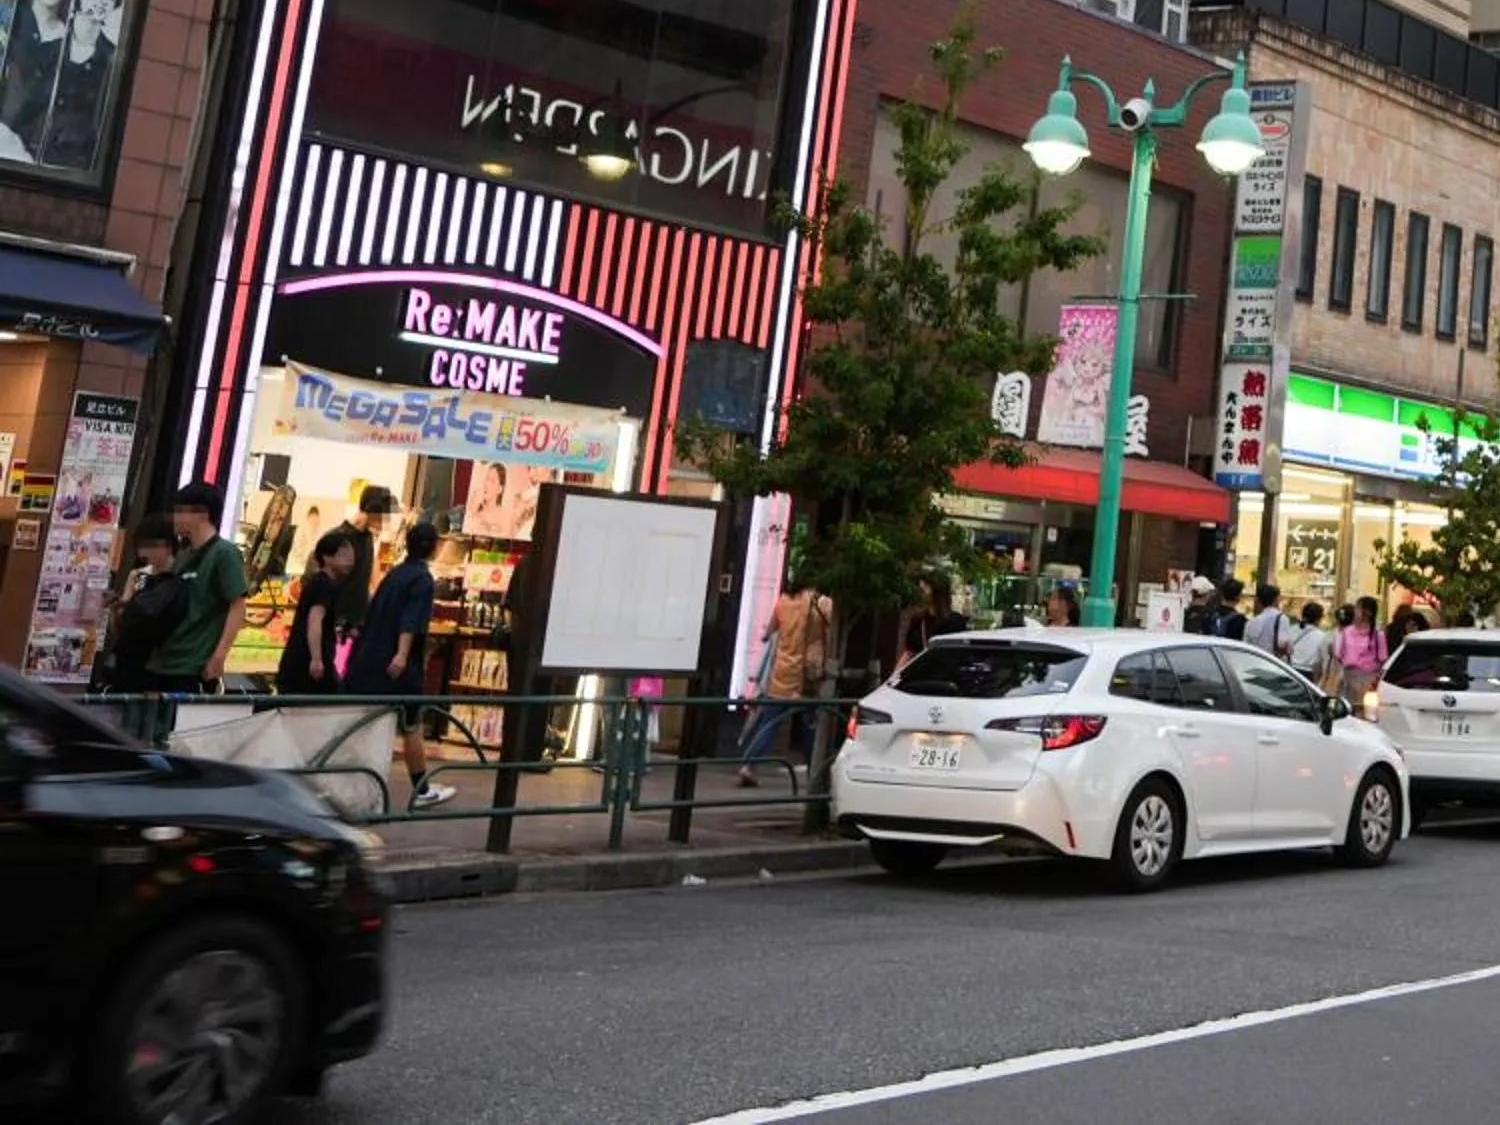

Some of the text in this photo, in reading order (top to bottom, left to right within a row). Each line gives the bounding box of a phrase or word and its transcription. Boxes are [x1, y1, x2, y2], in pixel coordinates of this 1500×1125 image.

[404, 288, 565, 355] Re:MAKE
[430, 349, 528, 397] COSME
[399, 390, 493, 446] SALE
[1312, 548, 1335, 570] 21
